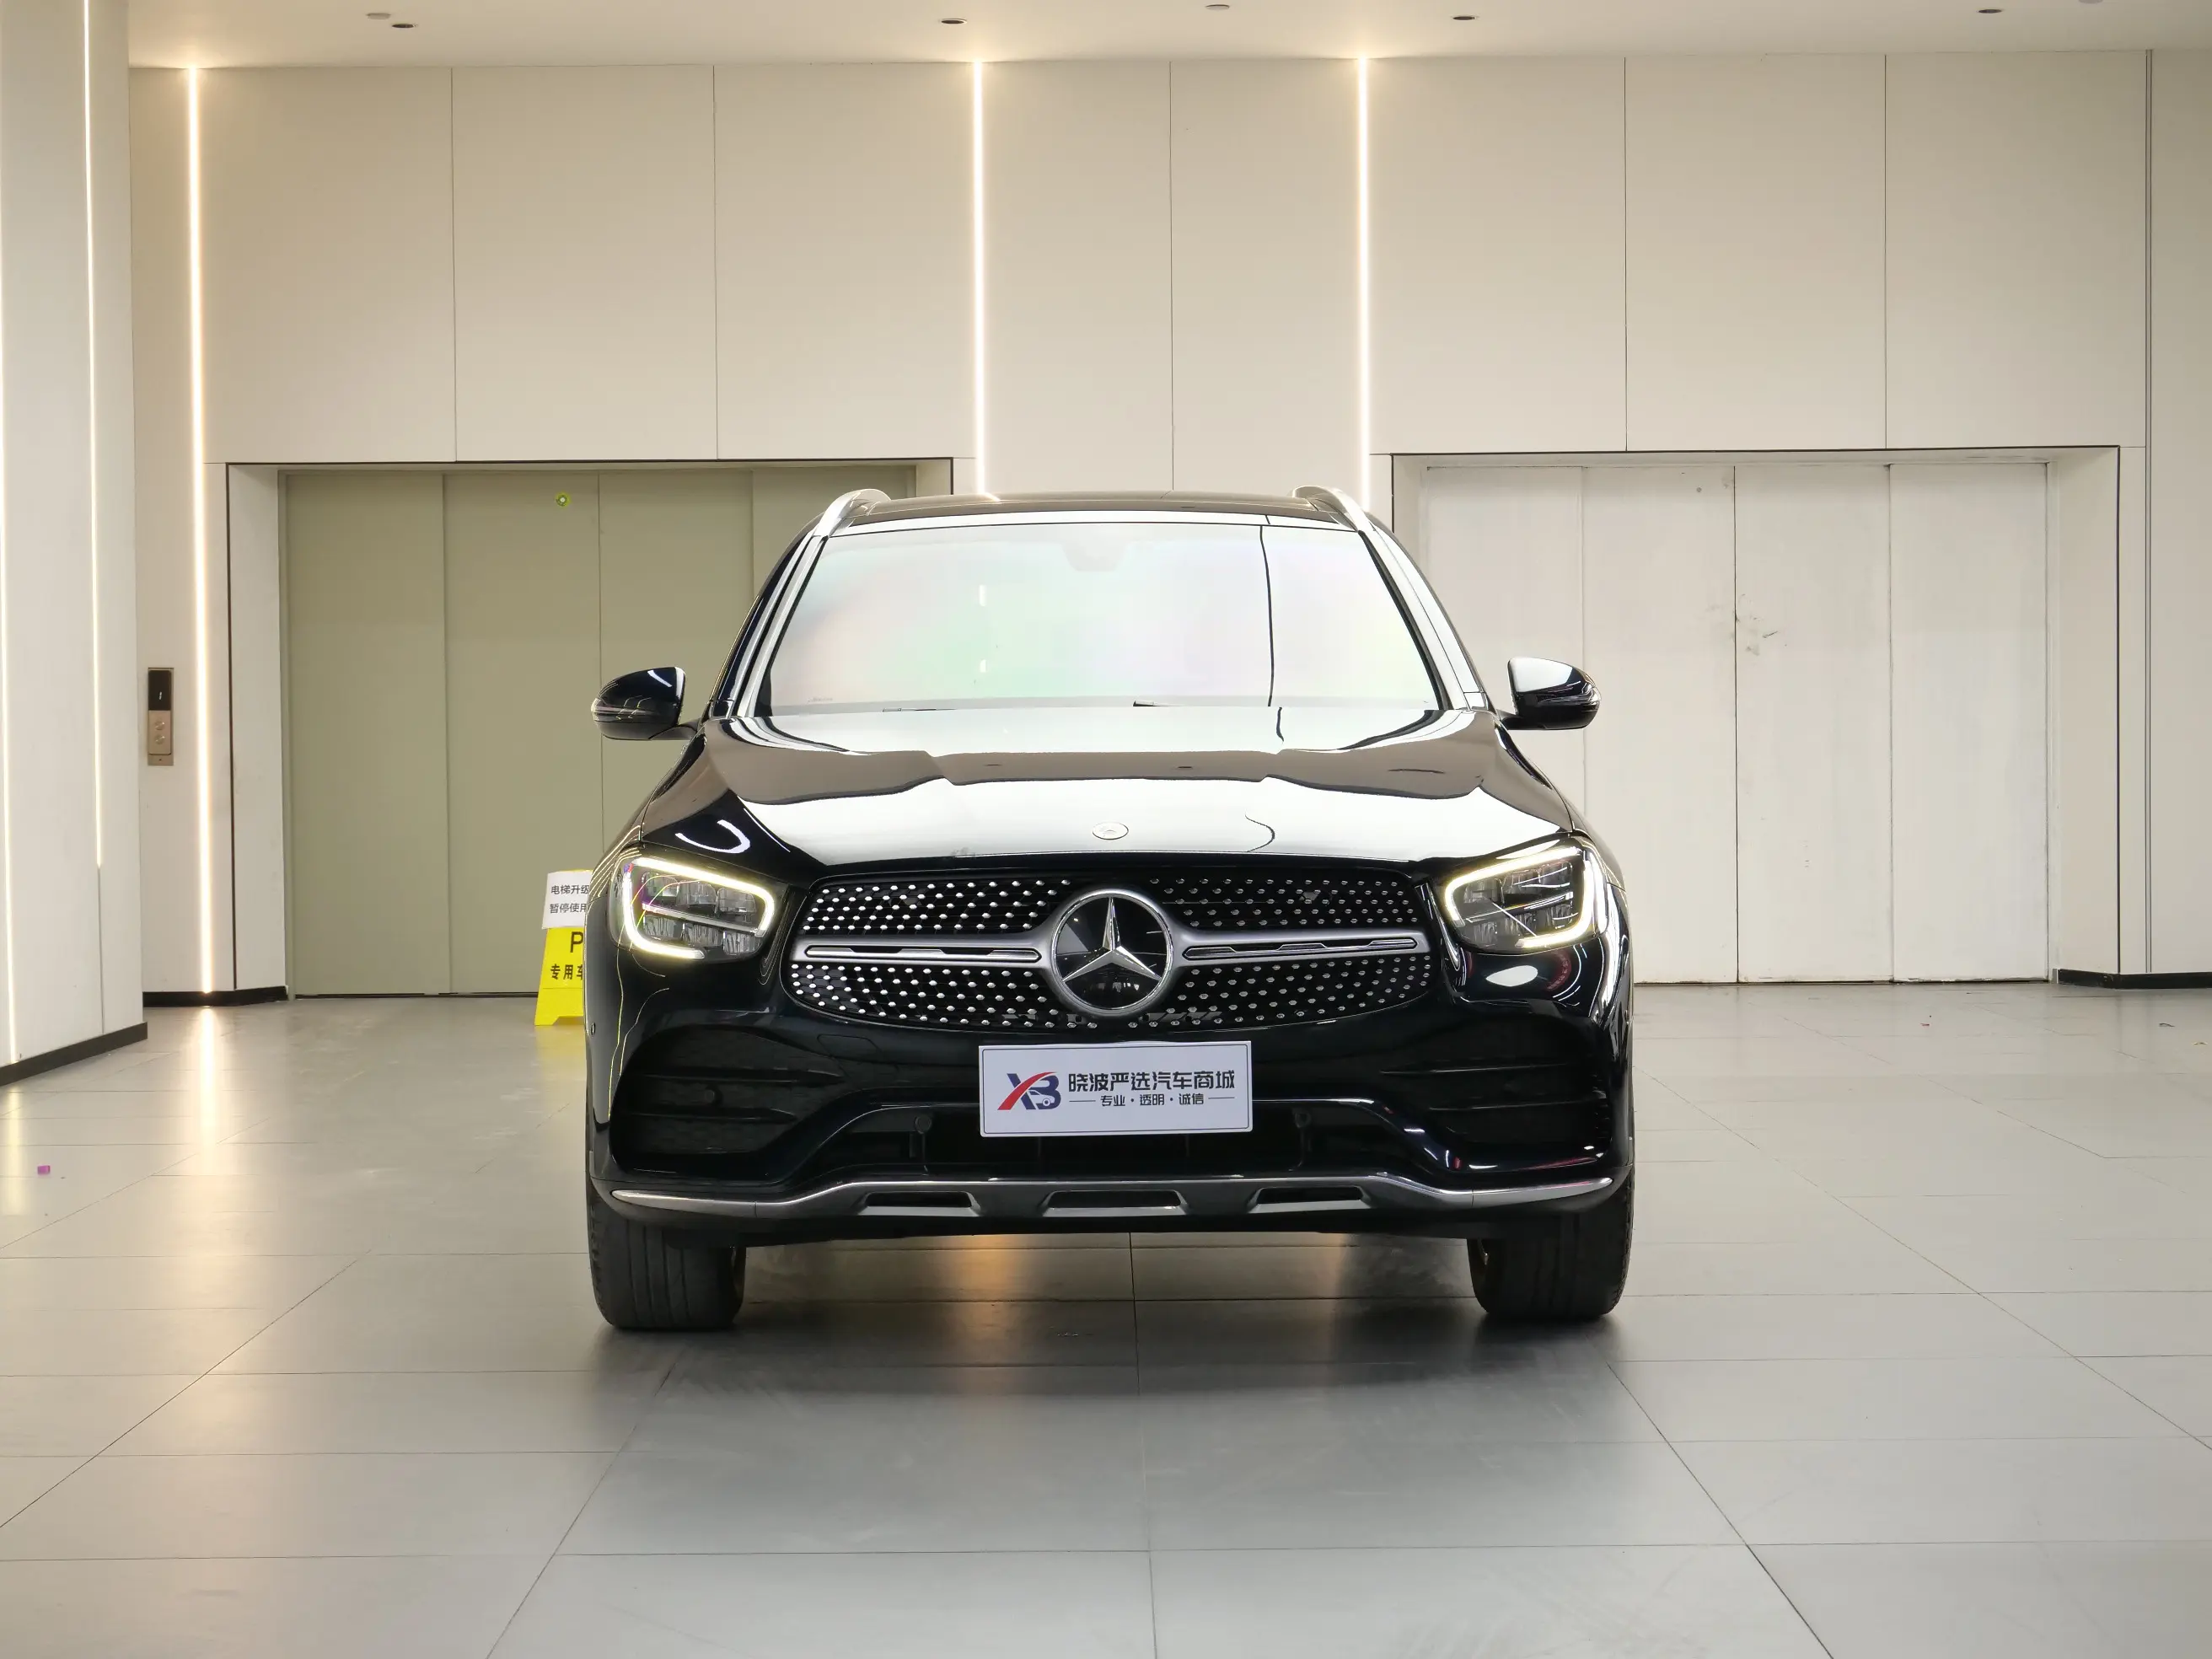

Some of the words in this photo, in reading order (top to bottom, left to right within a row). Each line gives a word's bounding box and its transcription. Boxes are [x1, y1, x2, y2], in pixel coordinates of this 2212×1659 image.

[550, 885, 589, 894] 电梯升级
[570, 932, 583, 953] P
[997, 1071, 1061, 1110] XB
[1068, 1070, 1236, 1092] 晓波严选汽车商城
